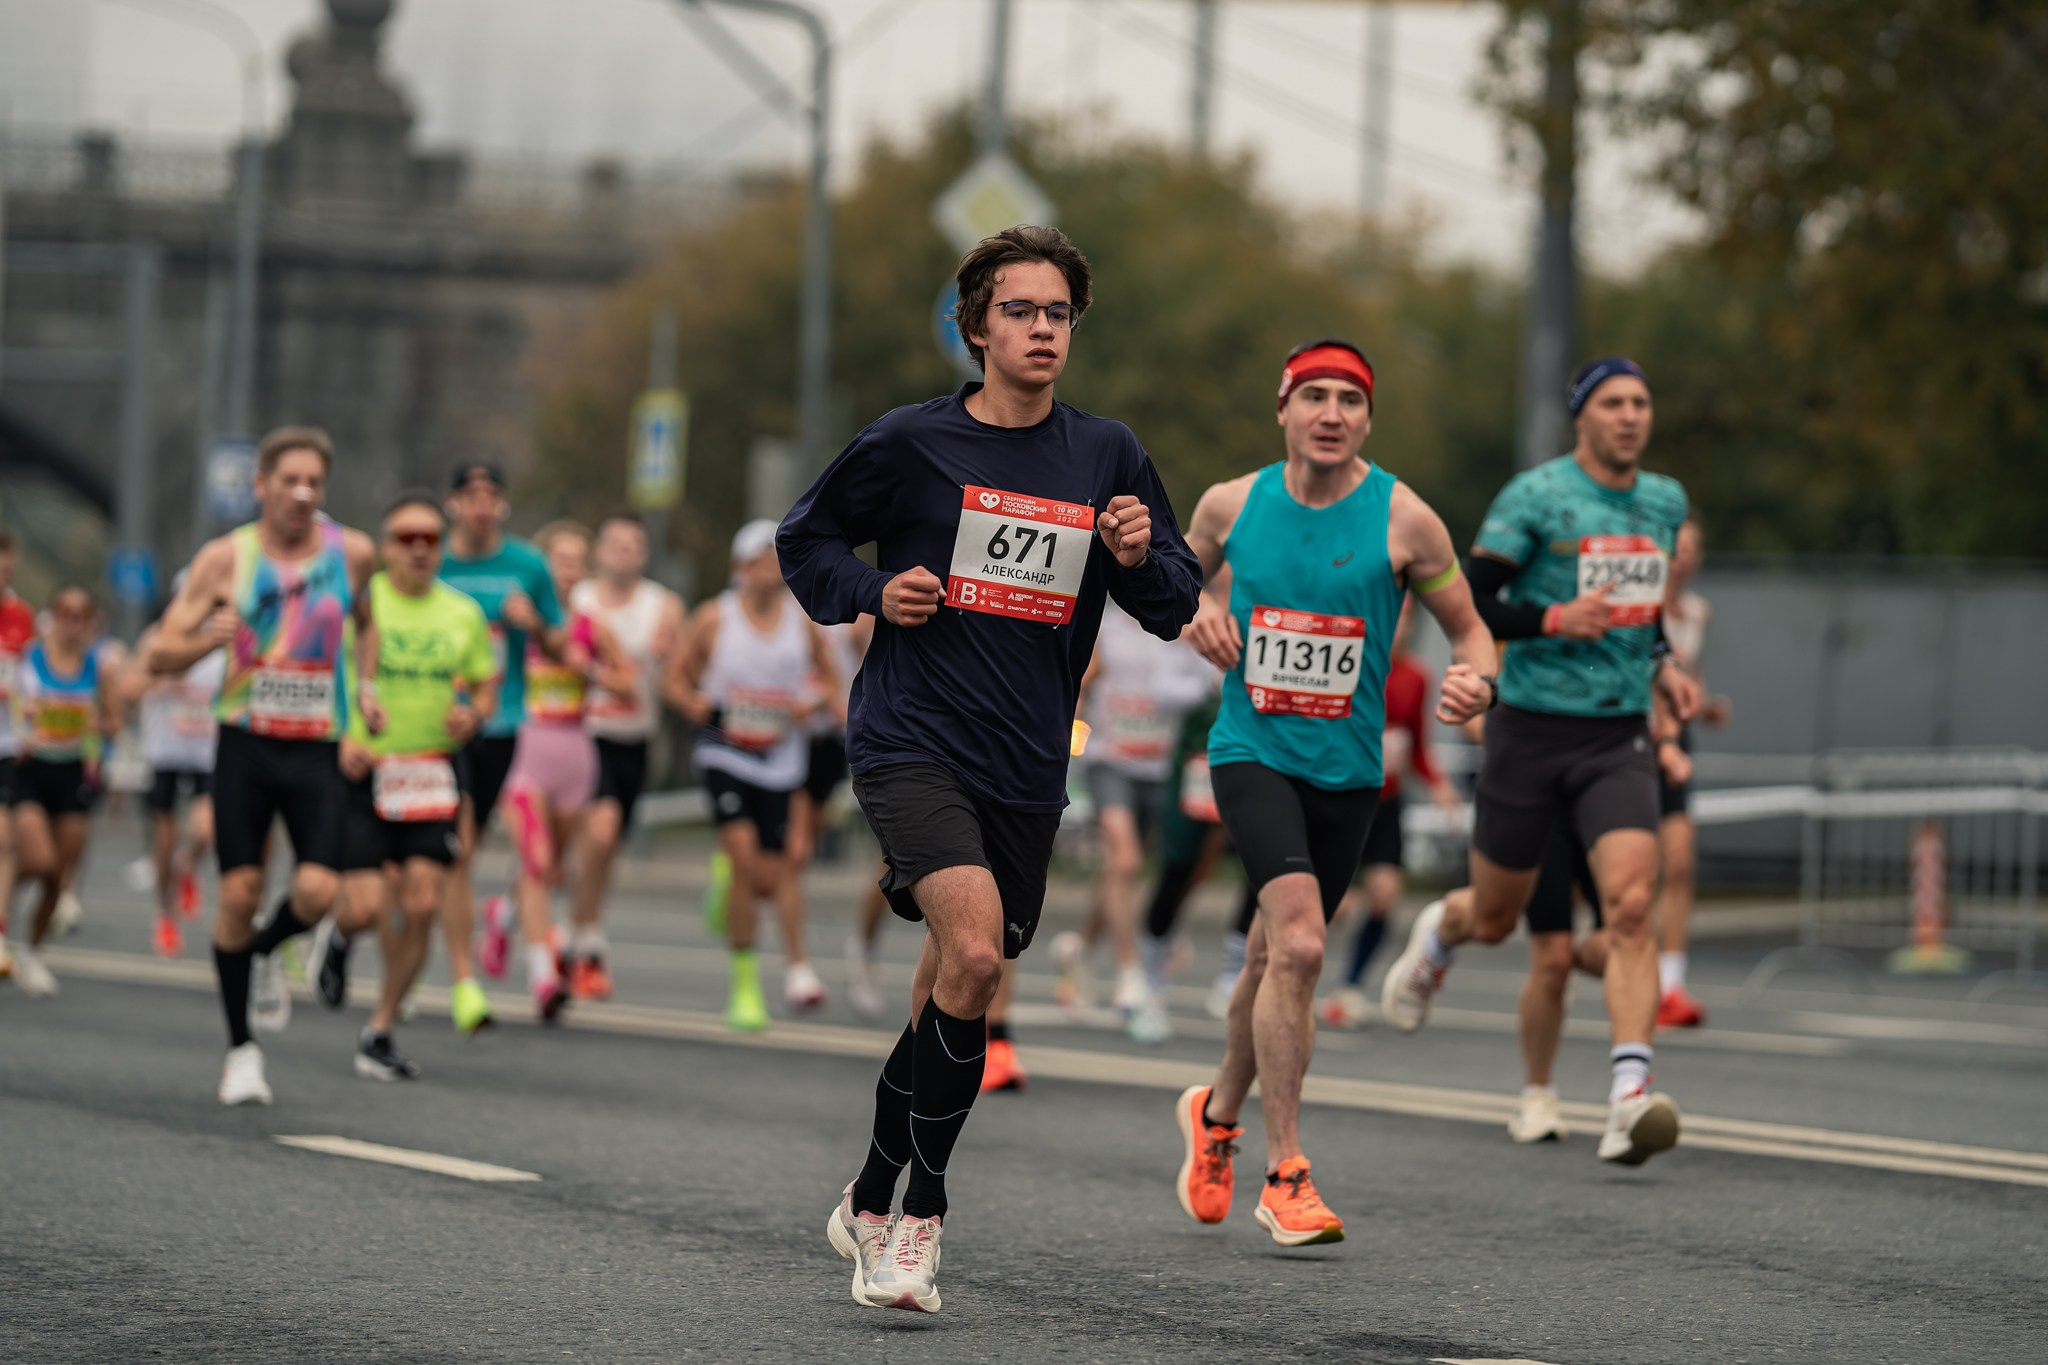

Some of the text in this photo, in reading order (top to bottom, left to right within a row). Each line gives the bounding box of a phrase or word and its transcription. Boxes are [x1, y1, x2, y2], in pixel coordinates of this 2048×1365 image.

[1001, 506, 1035, 517] МАРАФОН
[1002, 500, 1047, 513] МОСКОВСКИЙ
[1067, 507, 1078, 515] КМ
[987, 524, 1057, 568] 671
[981, 563, 1055, 586] АЛЕКСАНДР
[1255, 635, 1354, 675] 11316
